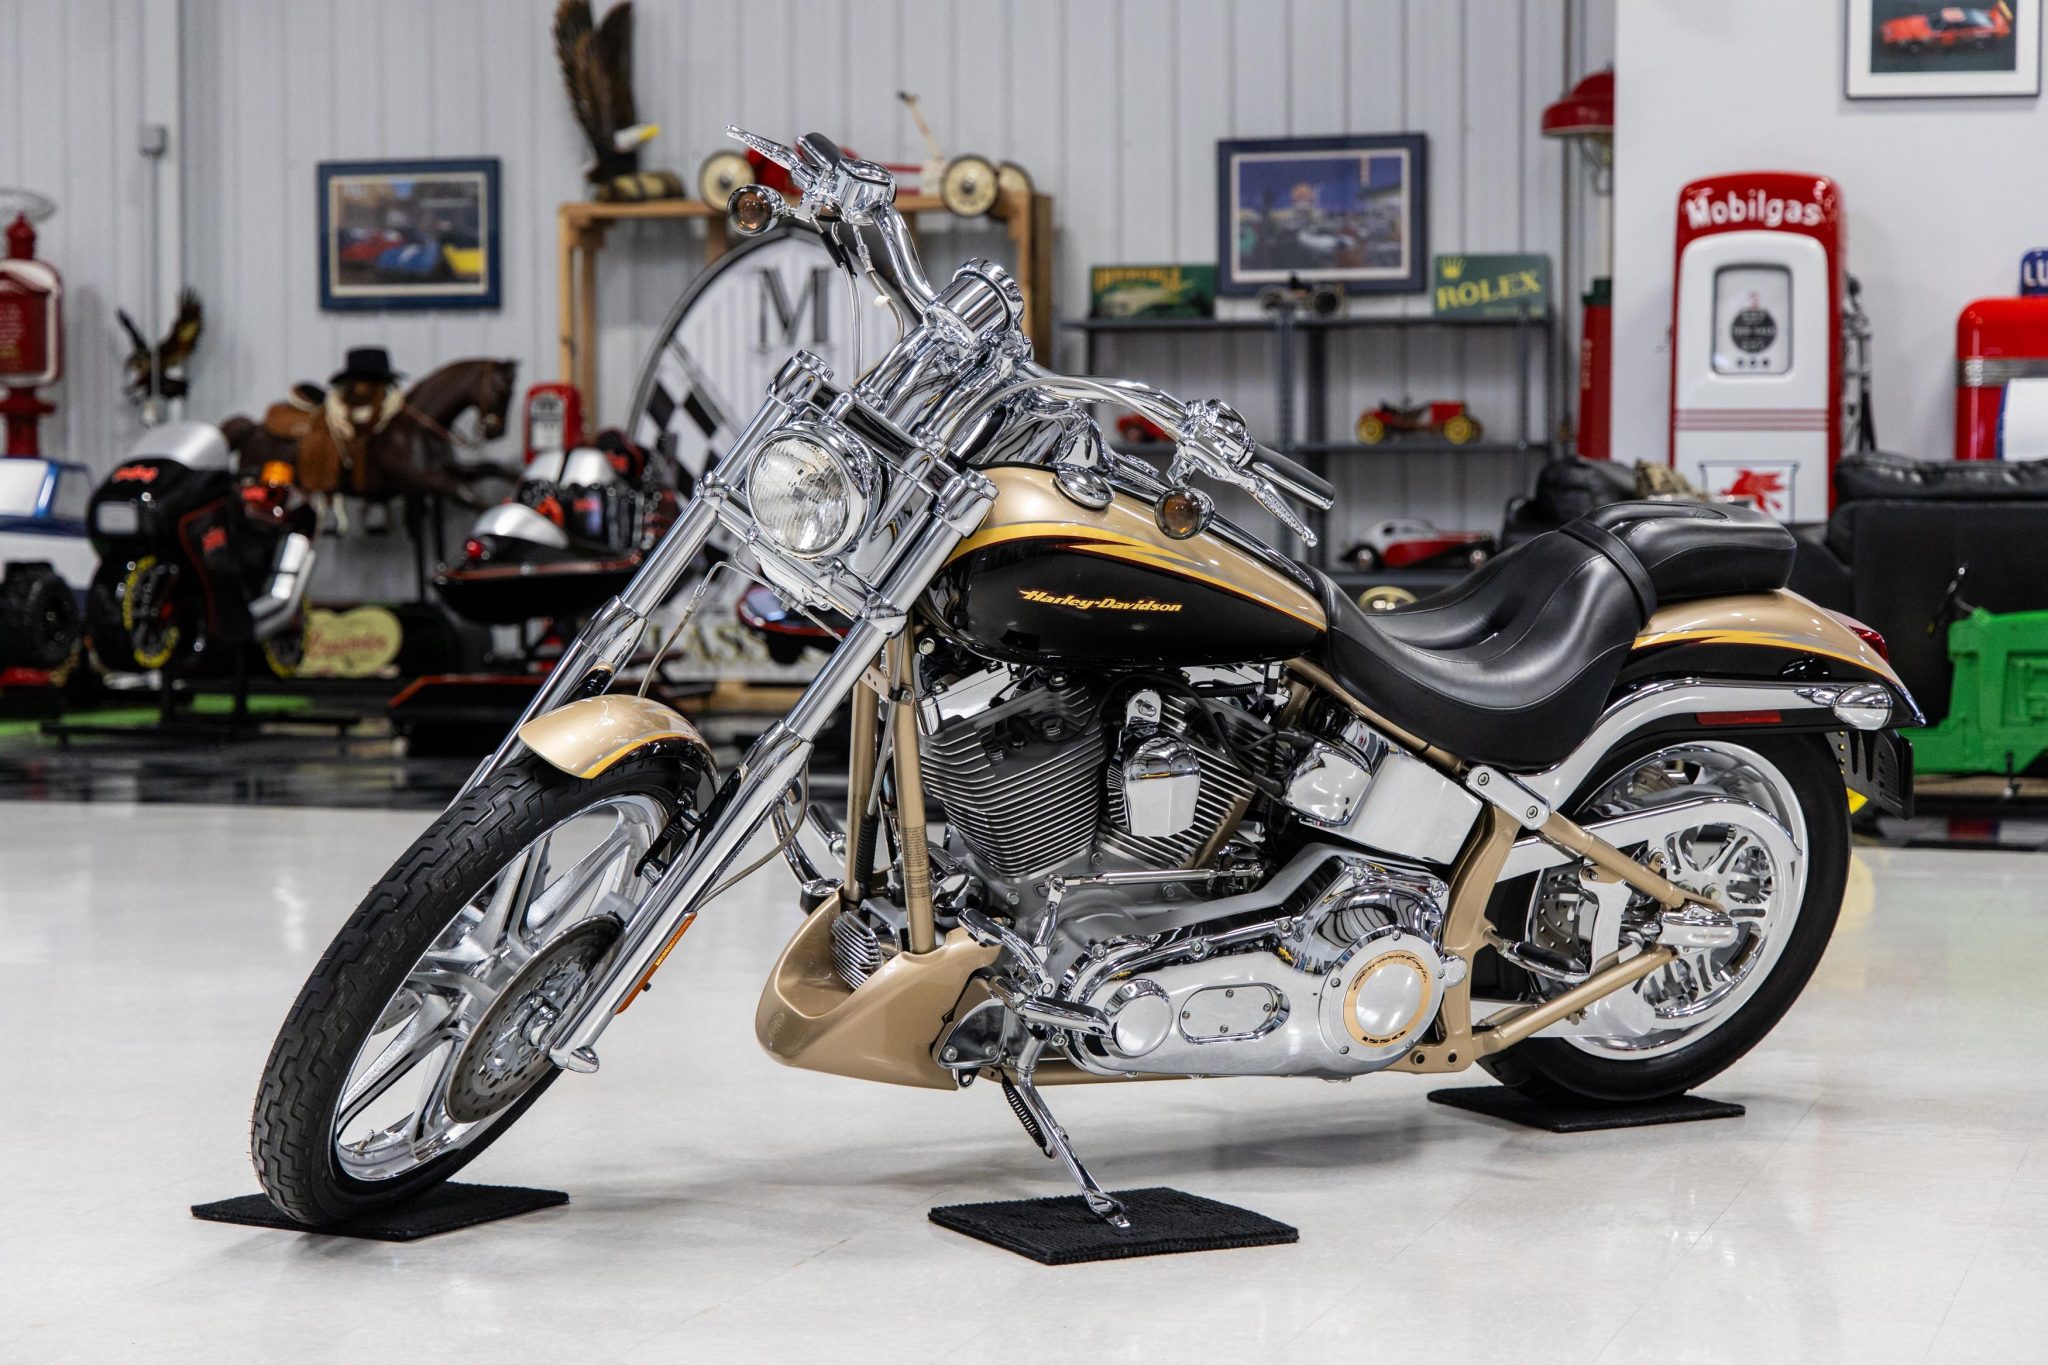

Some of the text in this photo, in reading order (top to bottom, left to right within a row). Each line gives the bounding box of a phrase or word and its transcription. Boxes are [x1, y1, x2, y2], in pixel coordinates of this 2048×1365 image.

[1685, 188, 1826, 229] Mobilgas
[756, 266, 832, 354] M
[1436, 269, 1541, 311] ROLEX
[1018, 588, 1183, 611] Harley-Davidson
[1361, 1030, 1407, 1044] 1550
